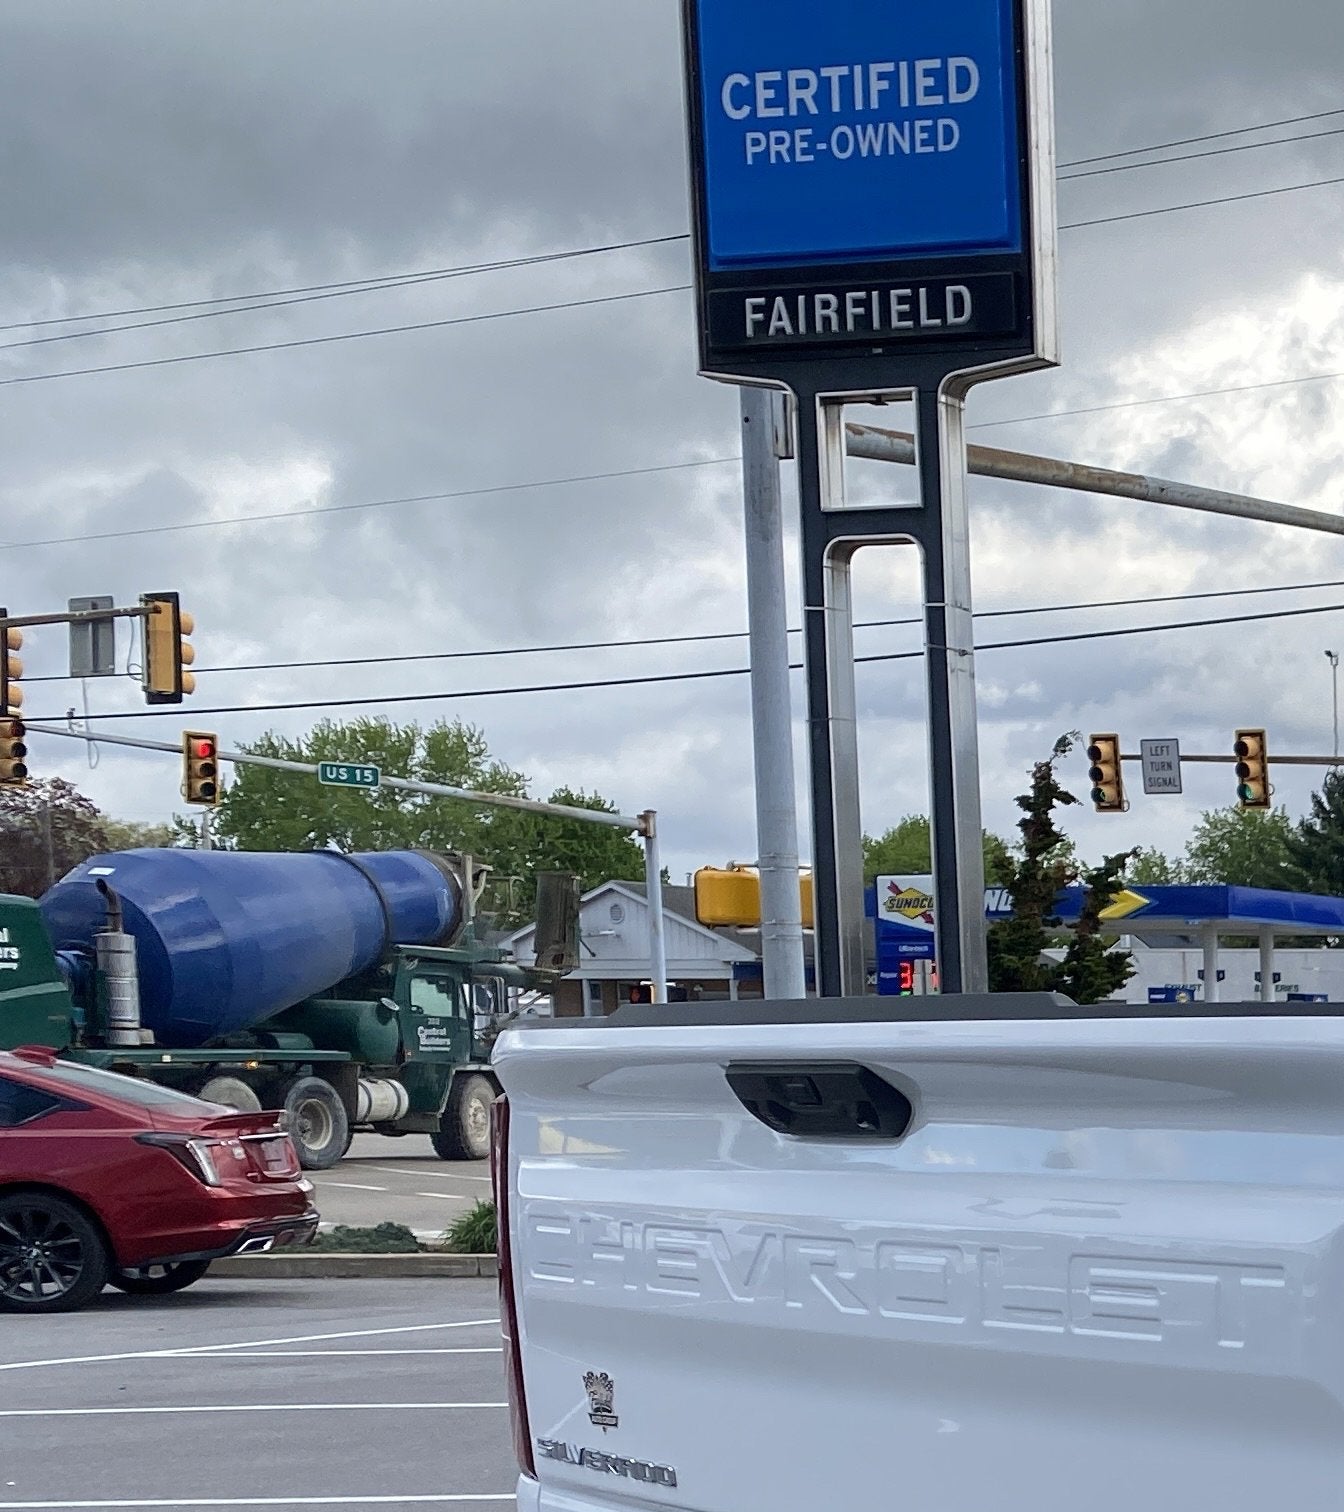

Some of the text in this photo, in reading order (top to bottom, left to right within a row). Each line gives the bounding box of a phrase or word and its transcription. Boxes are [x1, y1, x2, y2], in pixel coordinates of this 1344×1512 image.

[721, 56, 980, 120] CERTIFIED
[745, 118, 960, 165] PRE-OWNED
[745, 285, 972, 338] FAIRFIELD
[326, 766, 374, 782] US 15
[1150, 745, 1170, 756] LEFT
[1150, 761, 1173, 771] TURN
[1147, 776, 1178, 788] SIGNAL
[526, 1212, 1286, 1349] CHEVROLET
[537, 1437, 678, 1488] SILVERADO
